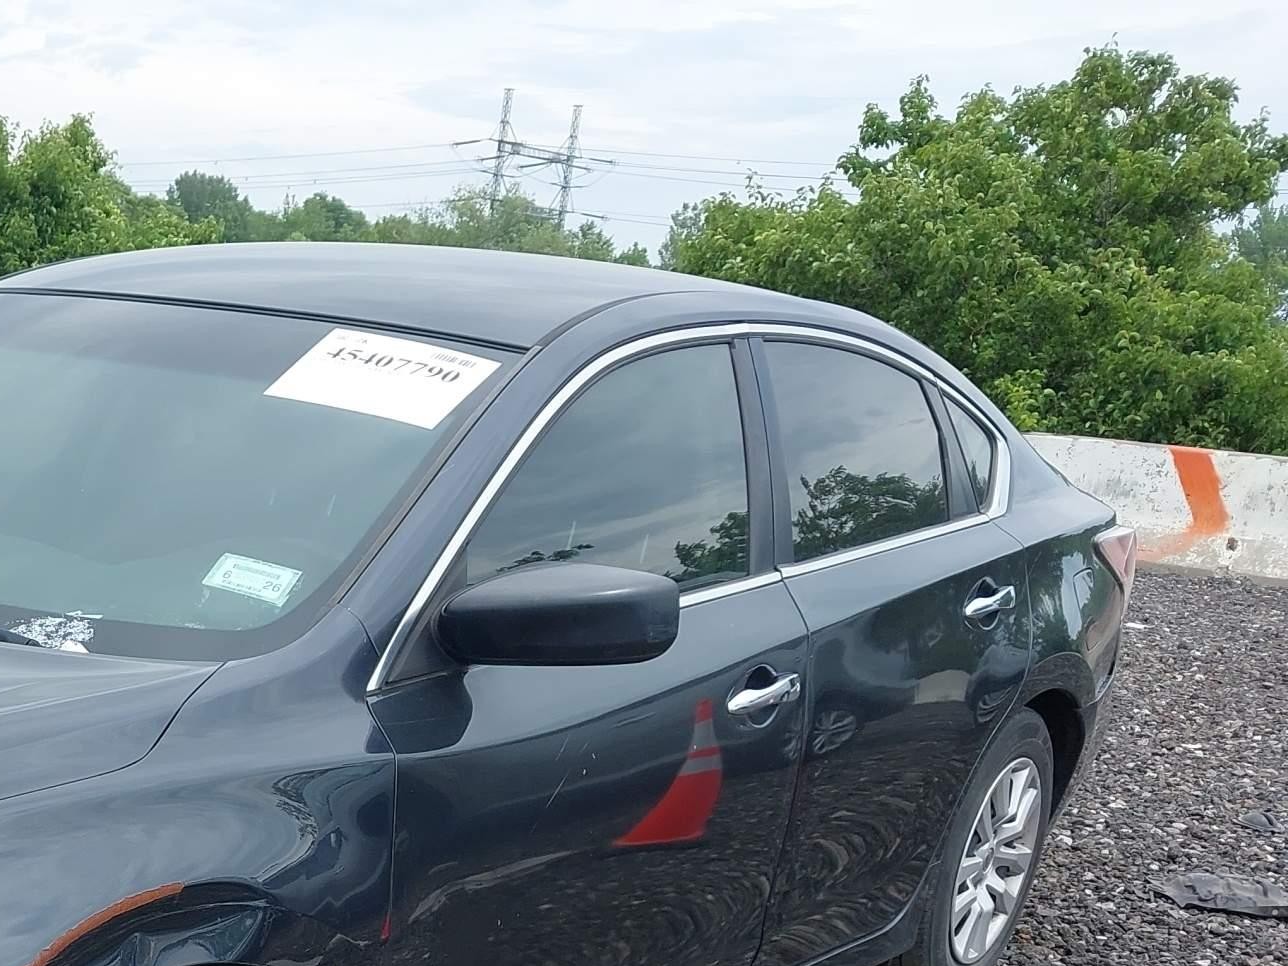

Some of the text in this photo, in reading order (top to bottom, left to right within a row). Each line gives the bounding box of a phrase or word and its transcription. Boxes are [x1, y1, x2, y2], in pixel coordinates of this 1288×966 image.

[326, 346, 461, 384] 45407790
[223, 570, 233, 579] 6
[262, 580, 283, 593] 26
